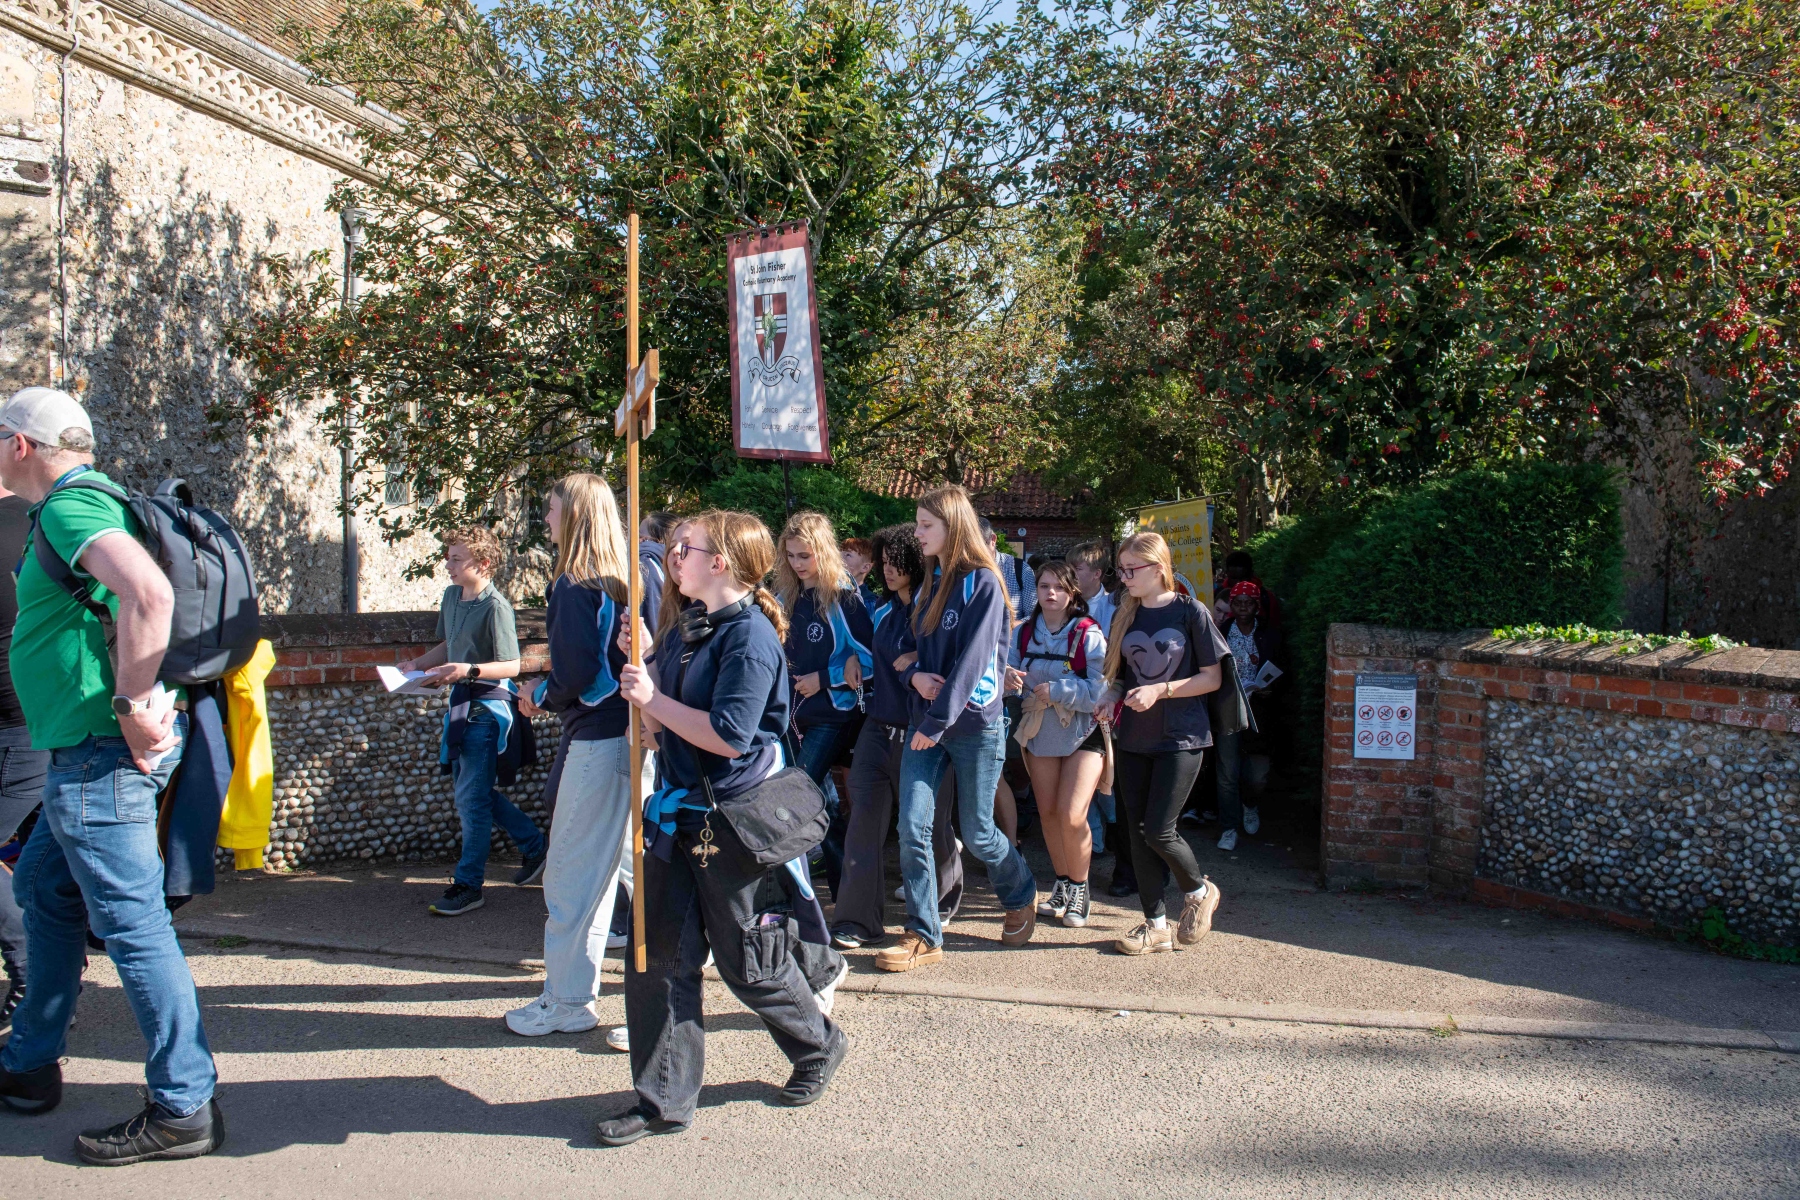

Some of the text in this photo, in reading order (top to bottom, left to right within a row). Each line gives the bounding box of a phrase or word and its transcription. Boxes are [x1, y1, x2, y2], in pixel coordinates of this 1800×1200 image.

[756, 264, 766, 273] John
[767, 261, 786, 271] Fisher
[777, 273, 796, 281] Academy
[791, 406, 811, 415] Respect
[761, 423, 782, 432] Courage
[788, 423, 817, 432] Forgiveness
[1160, 523, 1189, 535] All Saints
[1177, 536, 1202, 546] College
